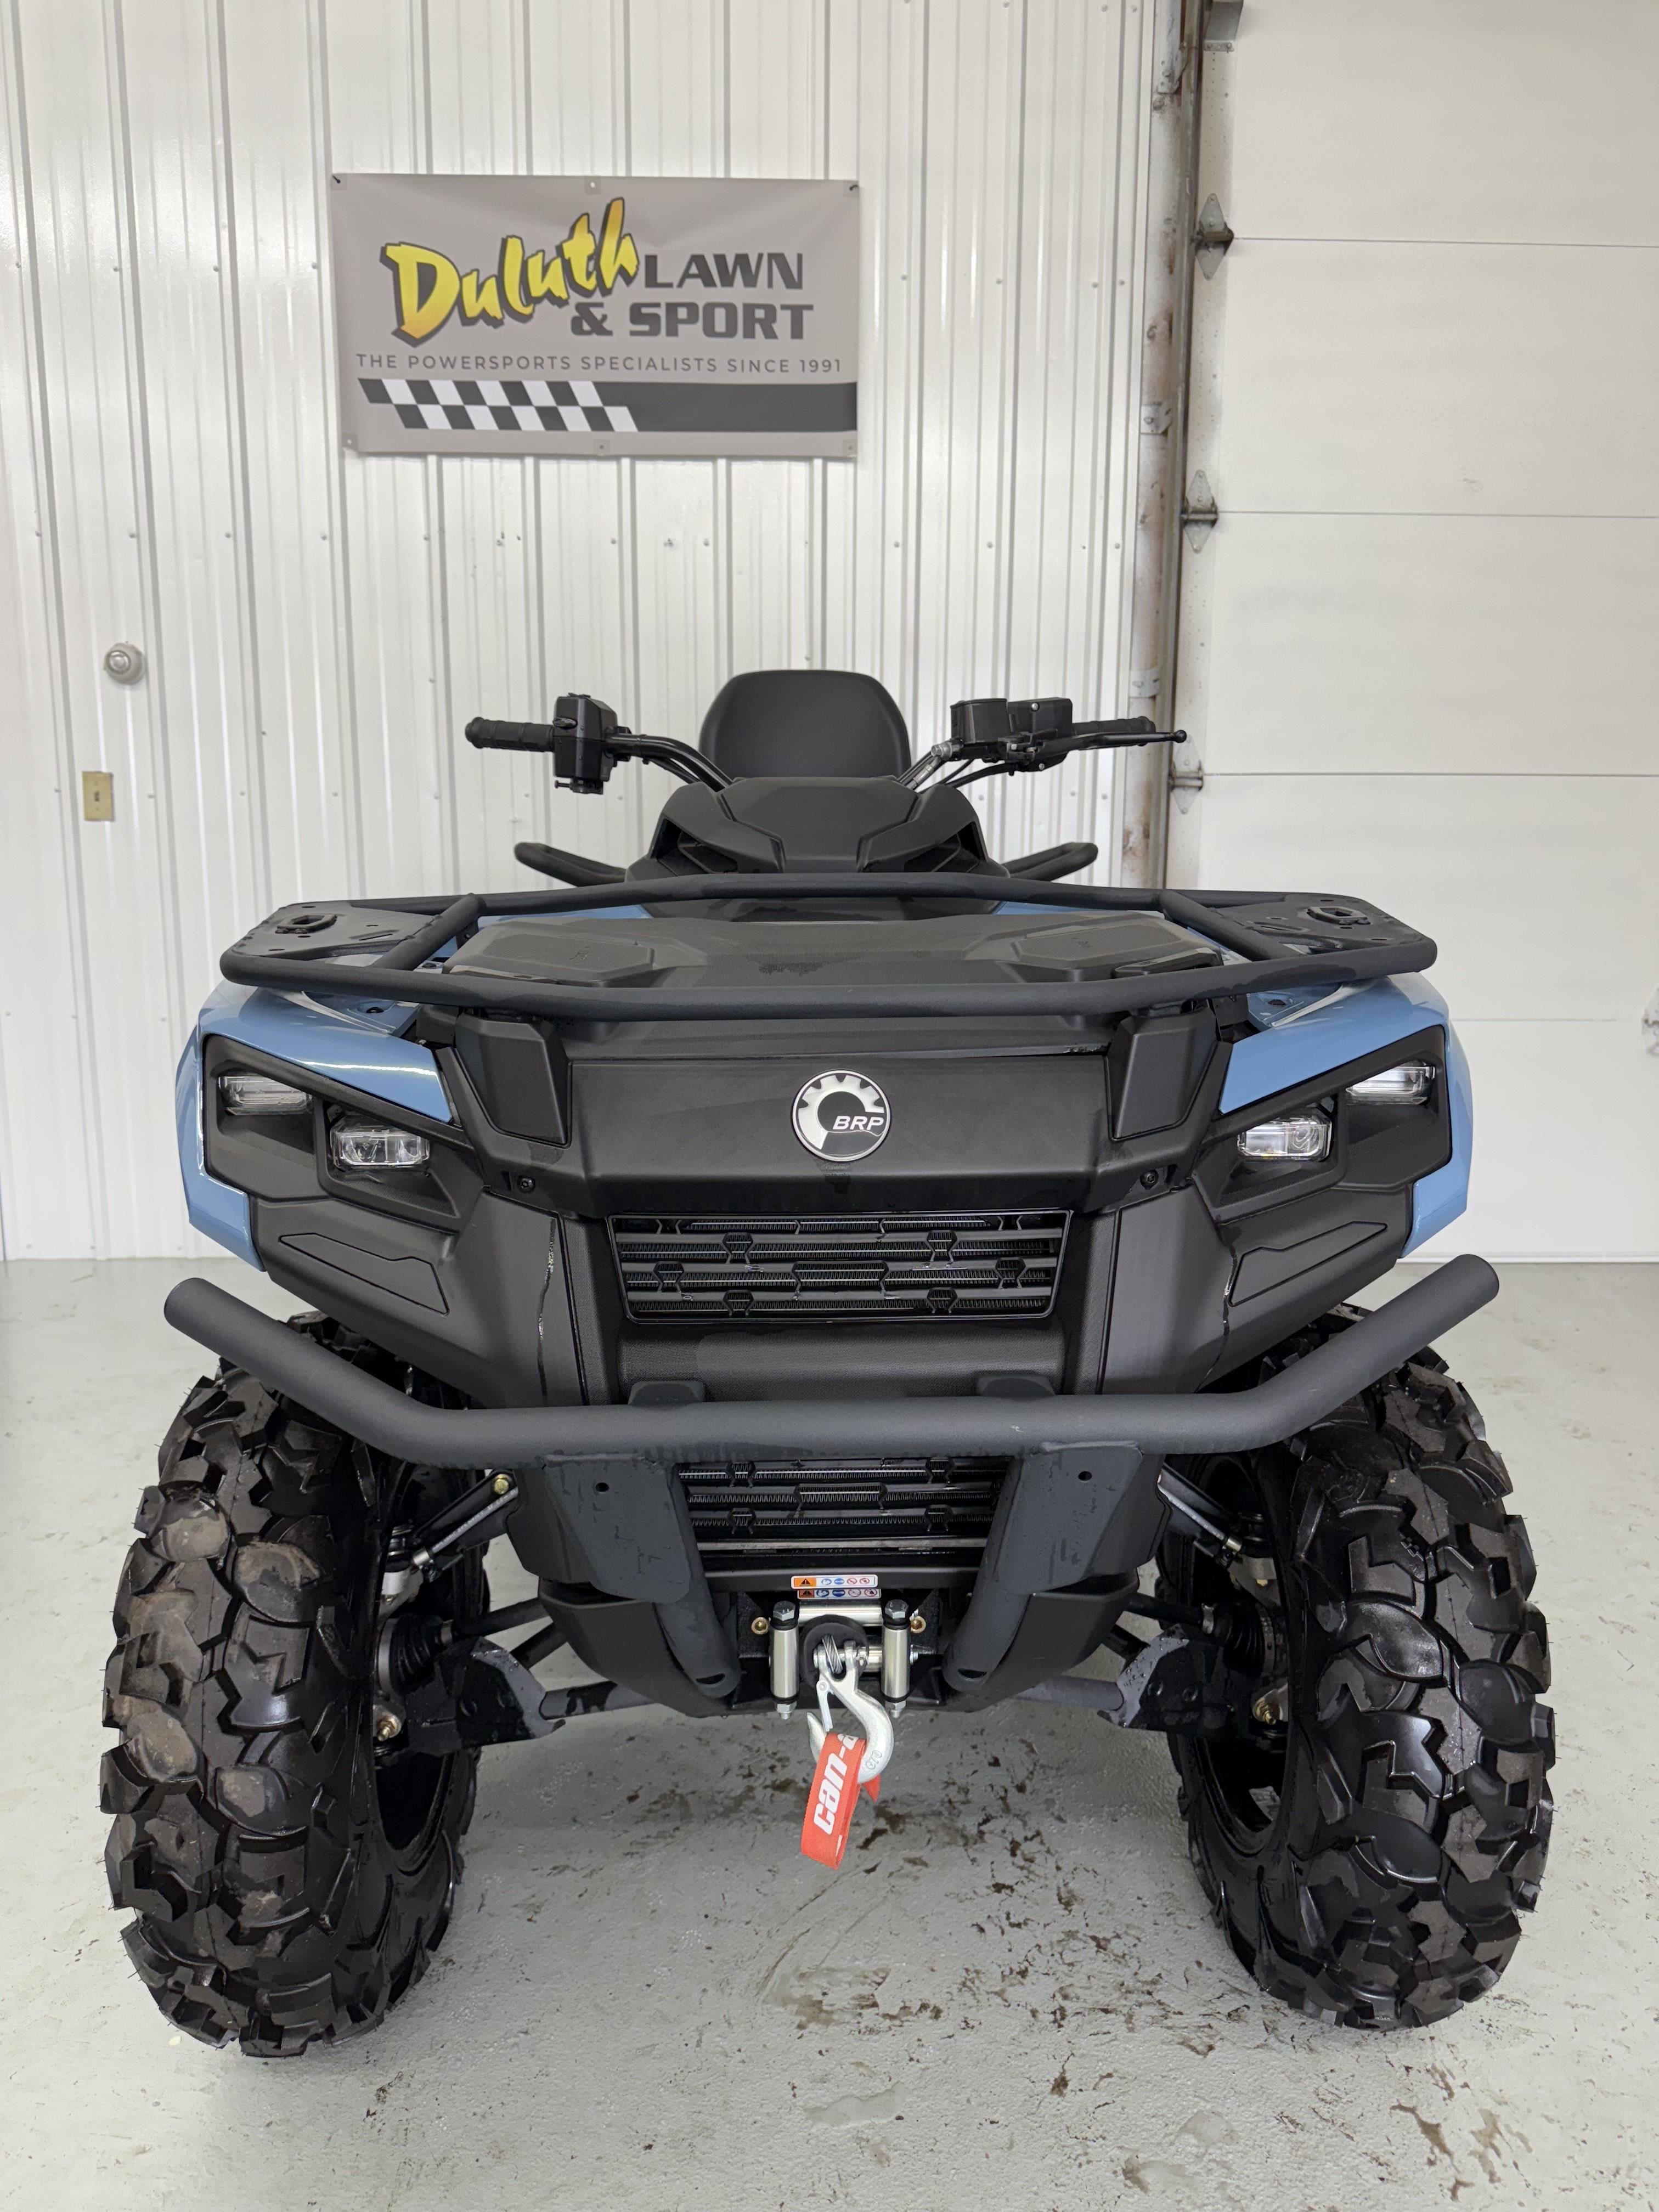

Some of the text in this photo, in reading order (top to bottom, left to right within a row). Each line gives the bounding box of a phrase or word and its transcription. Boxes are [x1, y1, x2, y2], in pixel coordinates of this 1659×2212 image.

[380, 198, 803, 347] Duluth LAWN
[571, 301, 814, 340] & SPORT
[356, 353, 840, 373] THE POWERSPORTS SPECIALISTS SINCE 1991
[832, 1115, 884, 1131] BRP
[865, 1749, 883, 1770] G70
